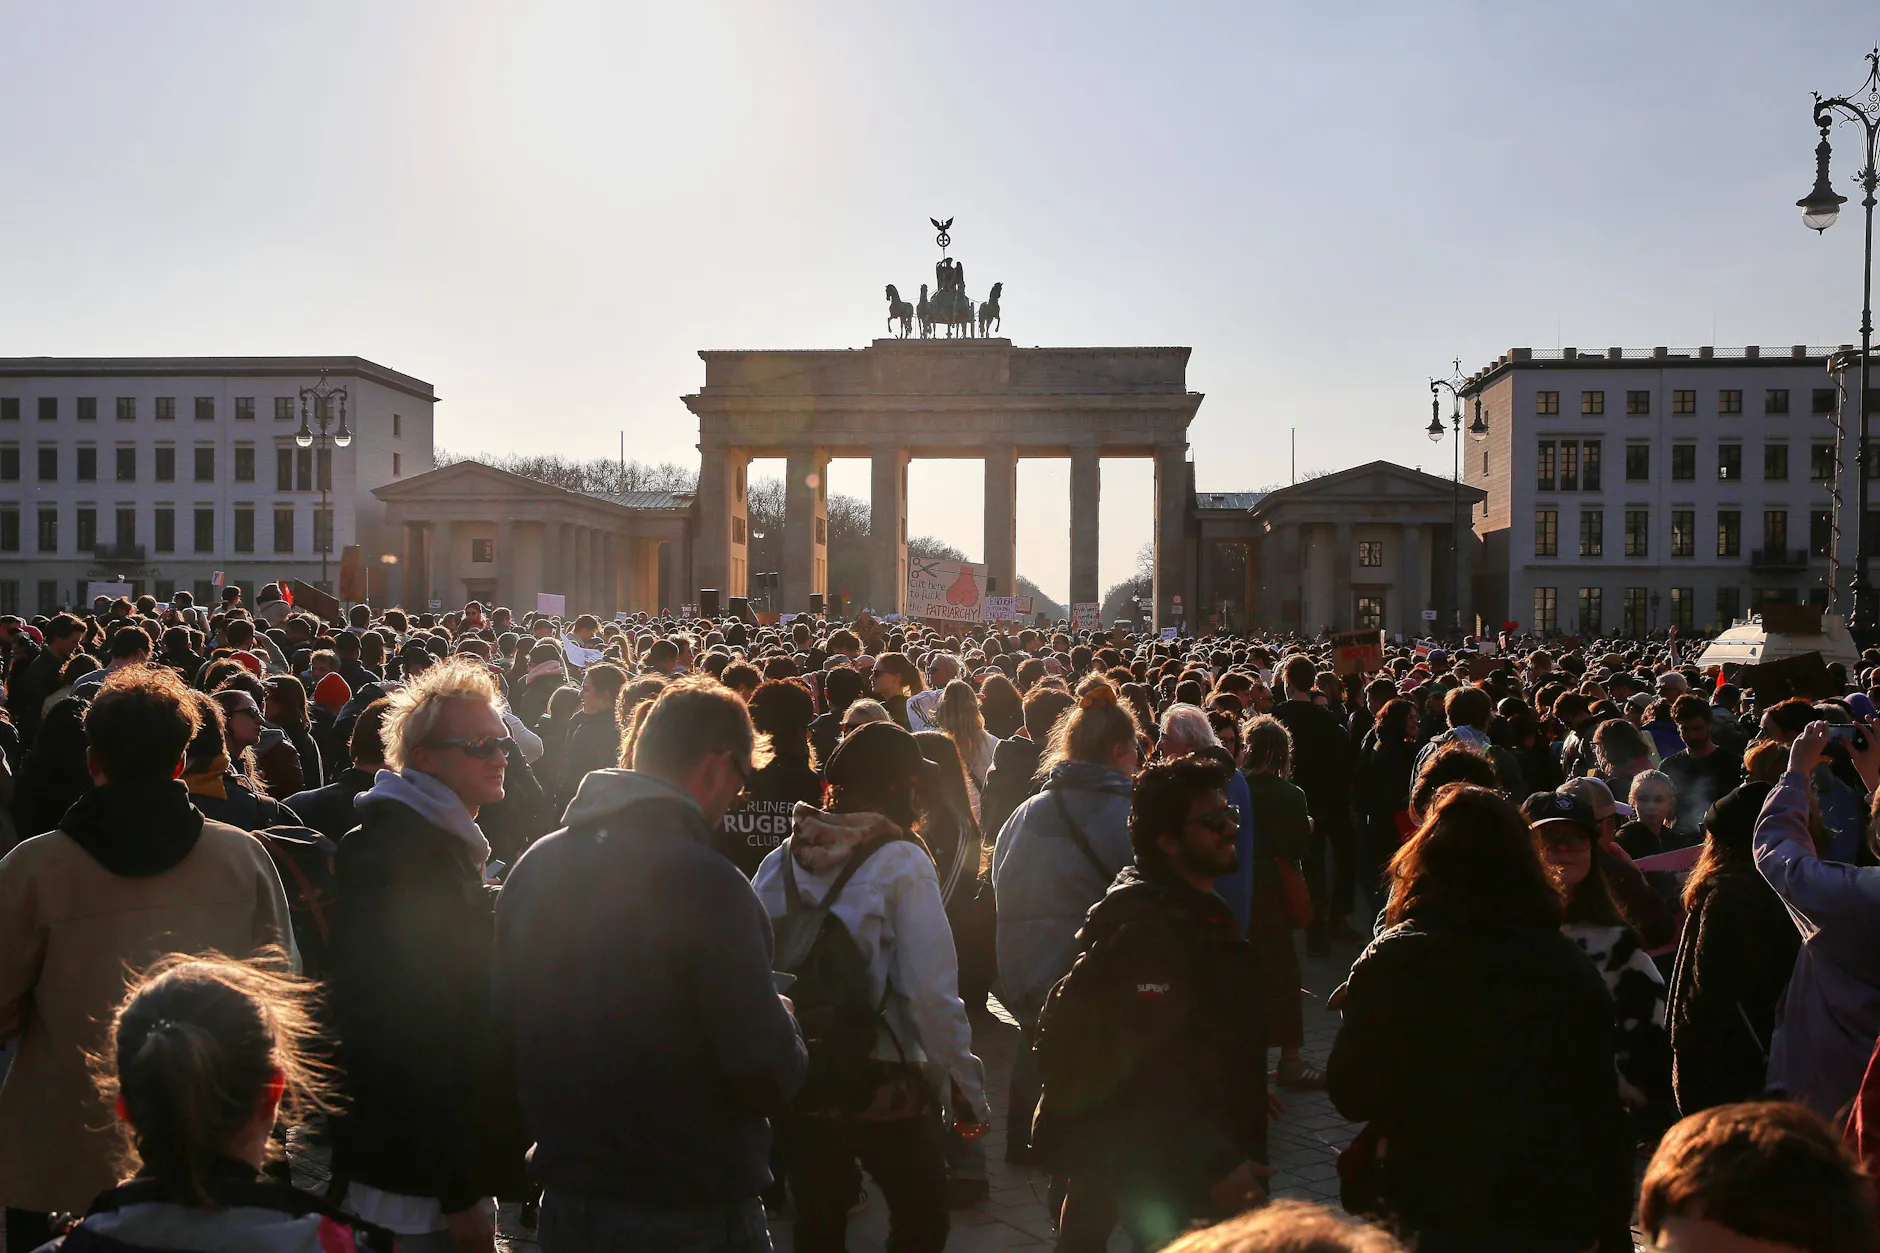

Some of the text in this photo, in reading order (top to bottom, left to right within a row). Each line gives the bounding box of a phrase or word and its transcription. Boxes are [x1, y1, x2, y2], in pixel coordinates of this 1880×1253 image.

[910, 578, 946, 591] Cut here
[909, 589, 941, 601] to fuck
[908, 601, 982, 622] the PATRIARCHY!
[747, 835, 780, 846] CLUB
